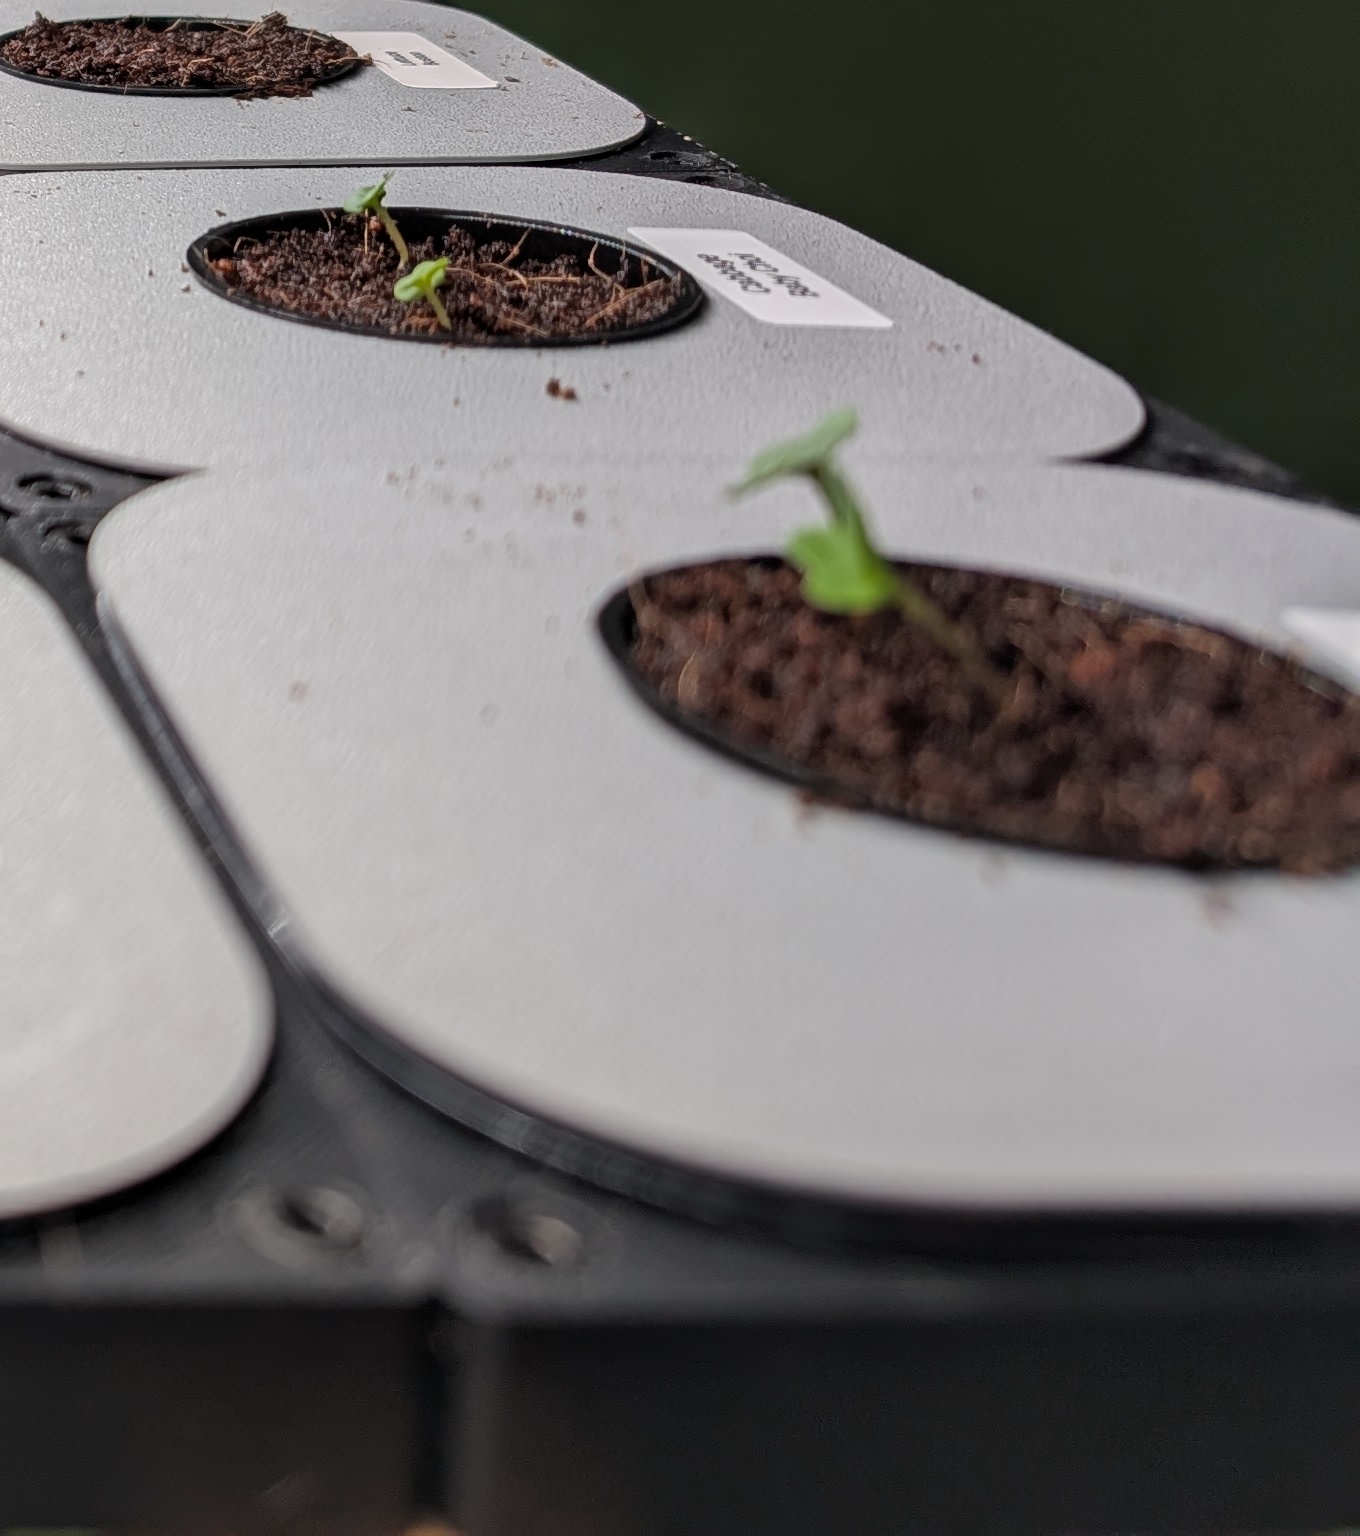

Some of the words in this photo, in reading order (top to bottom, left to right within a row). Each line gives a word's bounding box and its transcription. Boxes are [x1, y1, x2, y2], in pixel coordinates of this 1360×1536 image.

[697, 254, 771, 293] Cabbage
[728, 253, 779, 275] Choi
[766, 274, 820, 297] Baby
